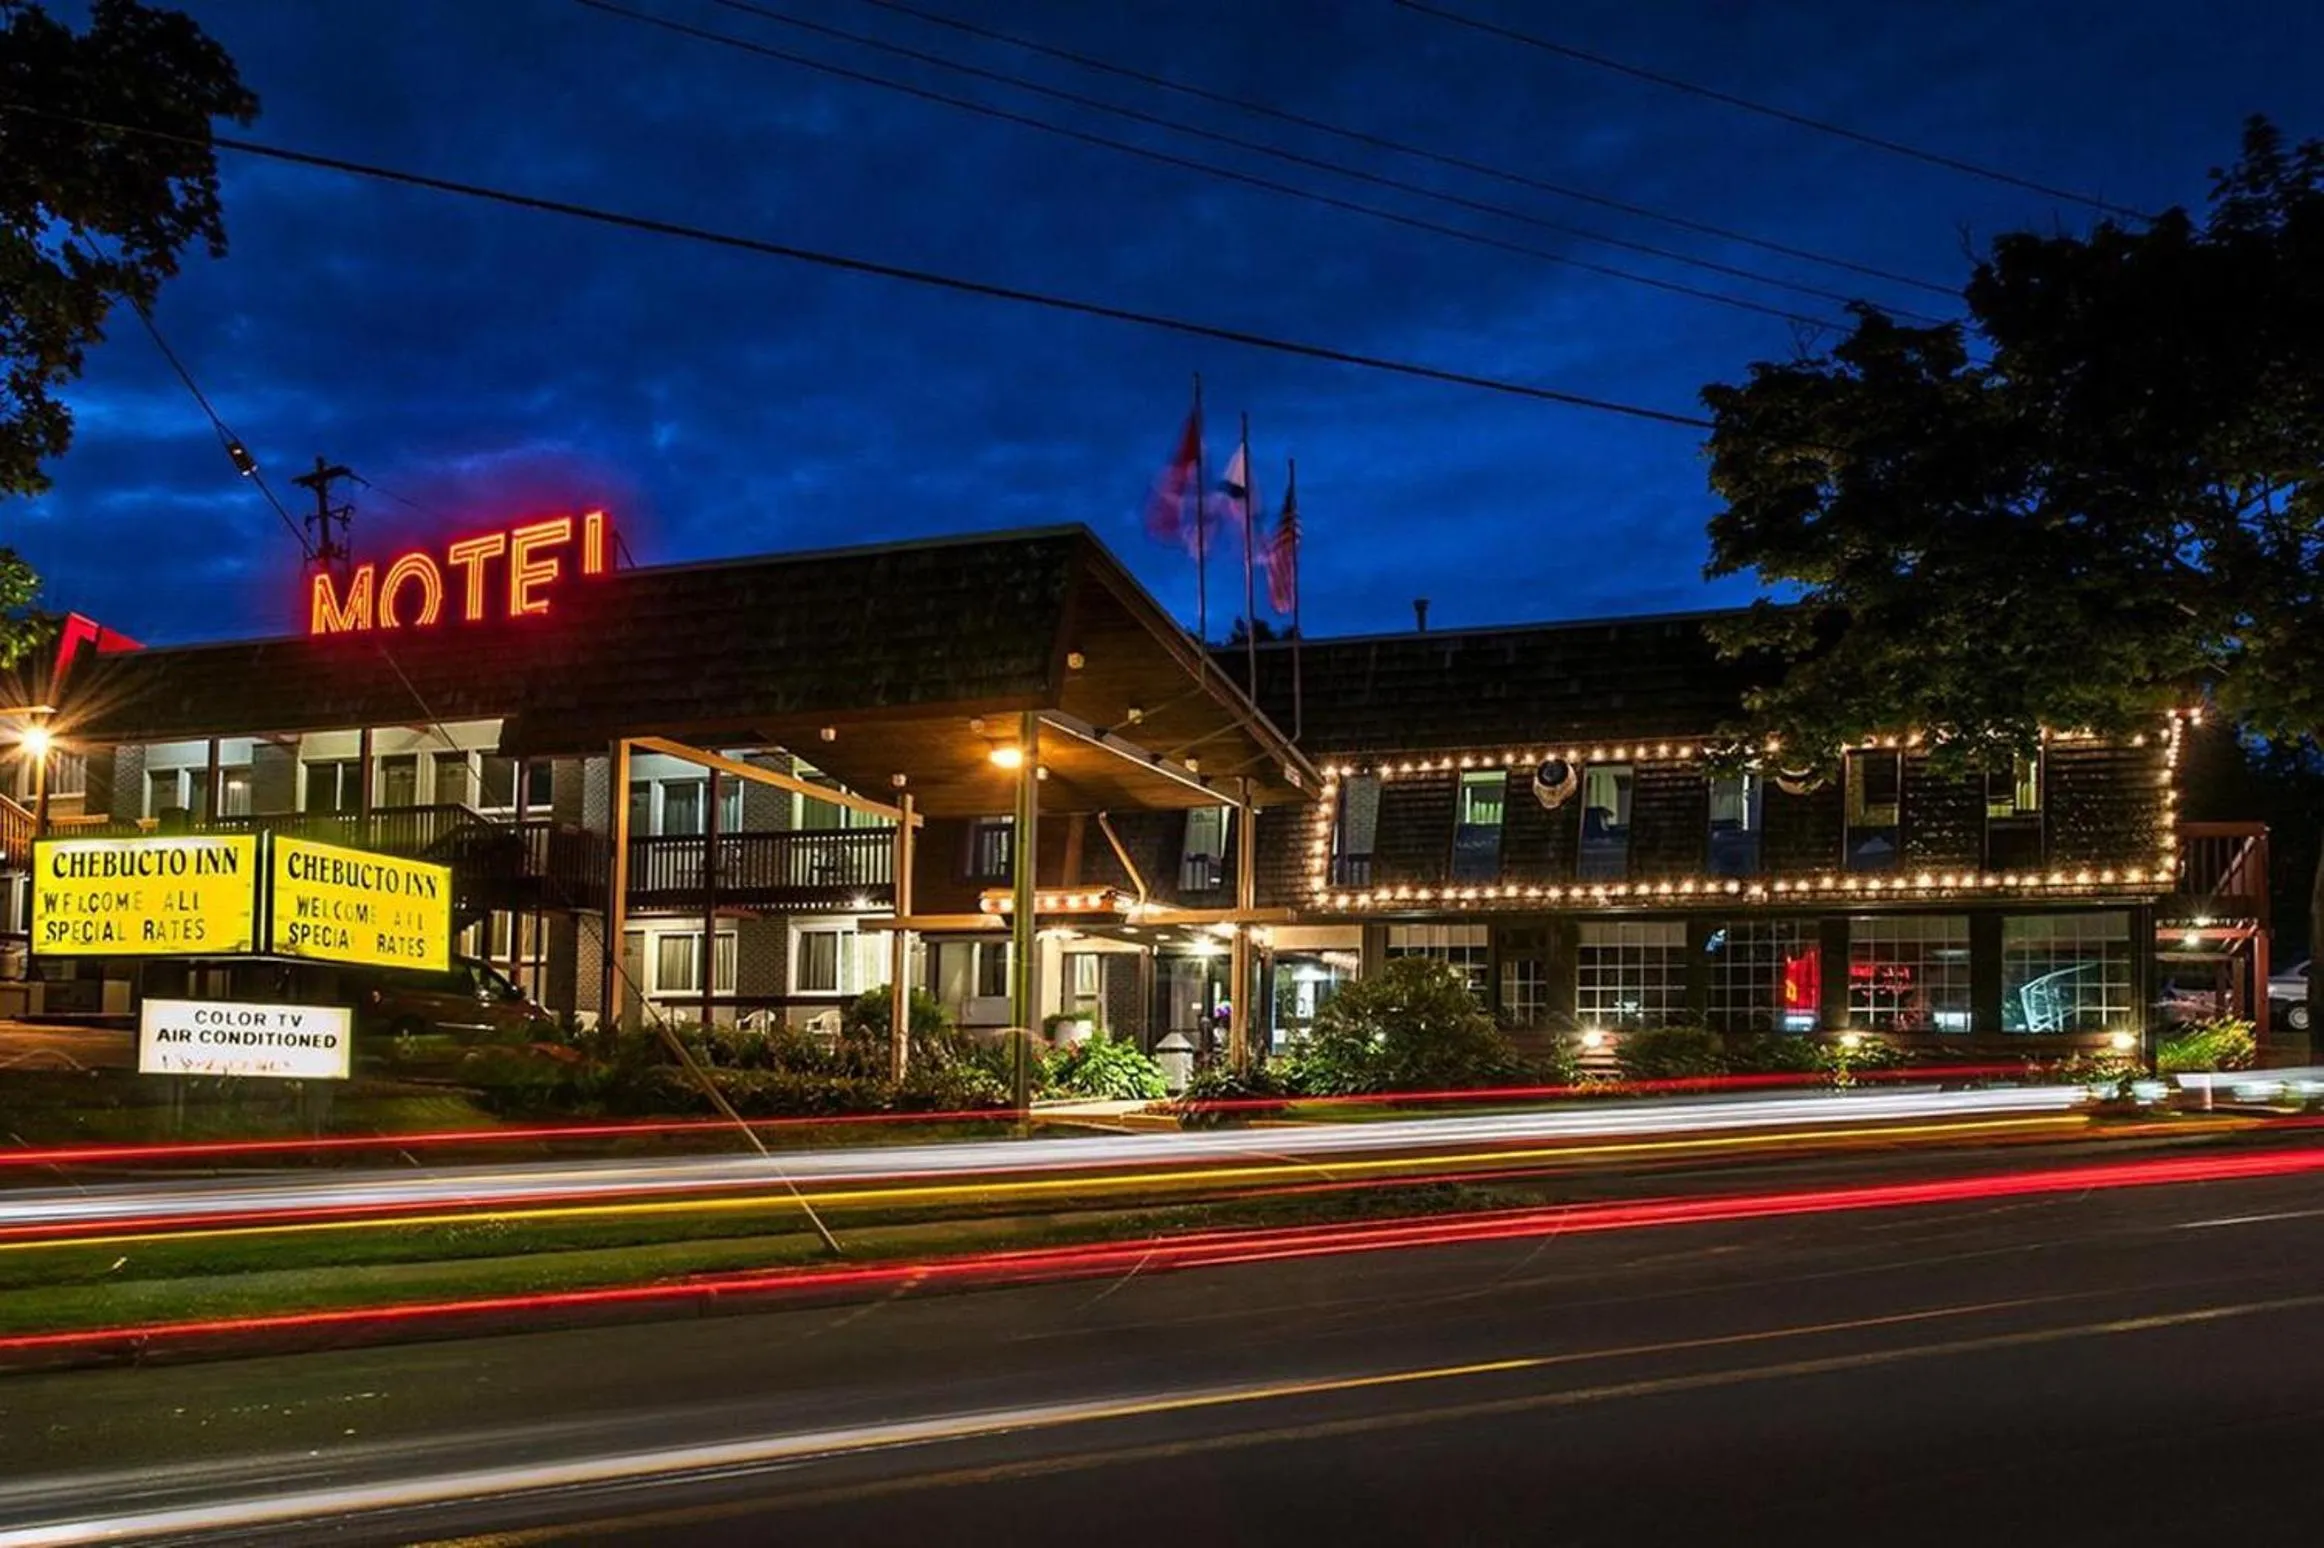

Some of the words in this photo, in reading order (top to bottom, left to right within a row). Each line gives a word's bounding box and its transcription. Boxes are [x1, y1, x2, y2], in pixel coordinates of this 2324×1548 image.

[53, 847, 187, 879] CHEBUCTO
[195, 846, 239, 875] INN
[287, 851, 399, 894] CHEBUCTO
[404, 871, 437, 899] INN
[45, 919, 127, 942] SPECIAL
[142, 918, 206, 941] RATES
[376, 933, 425, 958] RATES
[194, 1009, 267, 1027] COLOR
[277, 1013, 303, 1028] TV
[156, 1028, 193, 1044] AIR
[198, 1030, 338, 1049] CONDITIONED
